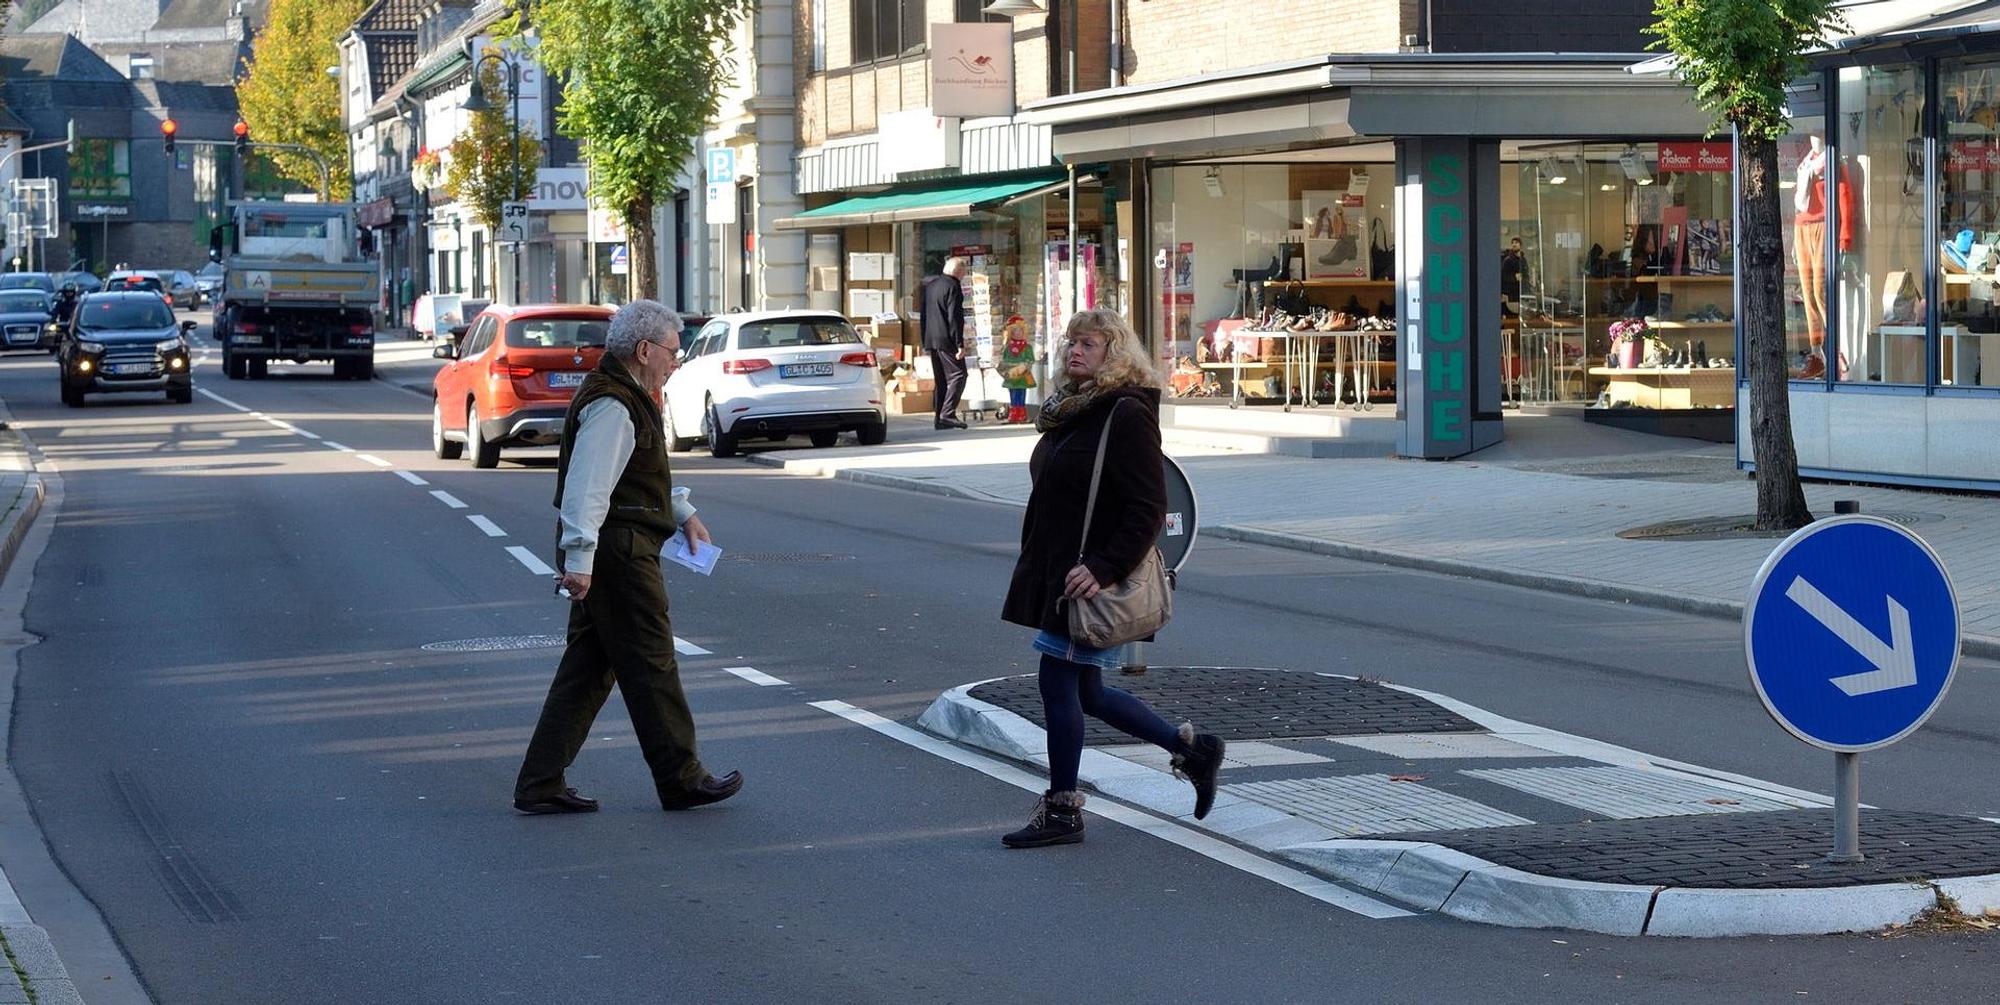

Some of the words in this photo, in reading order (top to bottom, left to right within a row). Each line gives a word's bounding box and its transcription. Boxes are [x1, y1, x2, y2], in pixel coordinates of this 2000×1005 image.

[713, 152, 729, 177] P
[253, 275, 265, 288] A
[1427, 155, 1465, 441] SCHUHE
